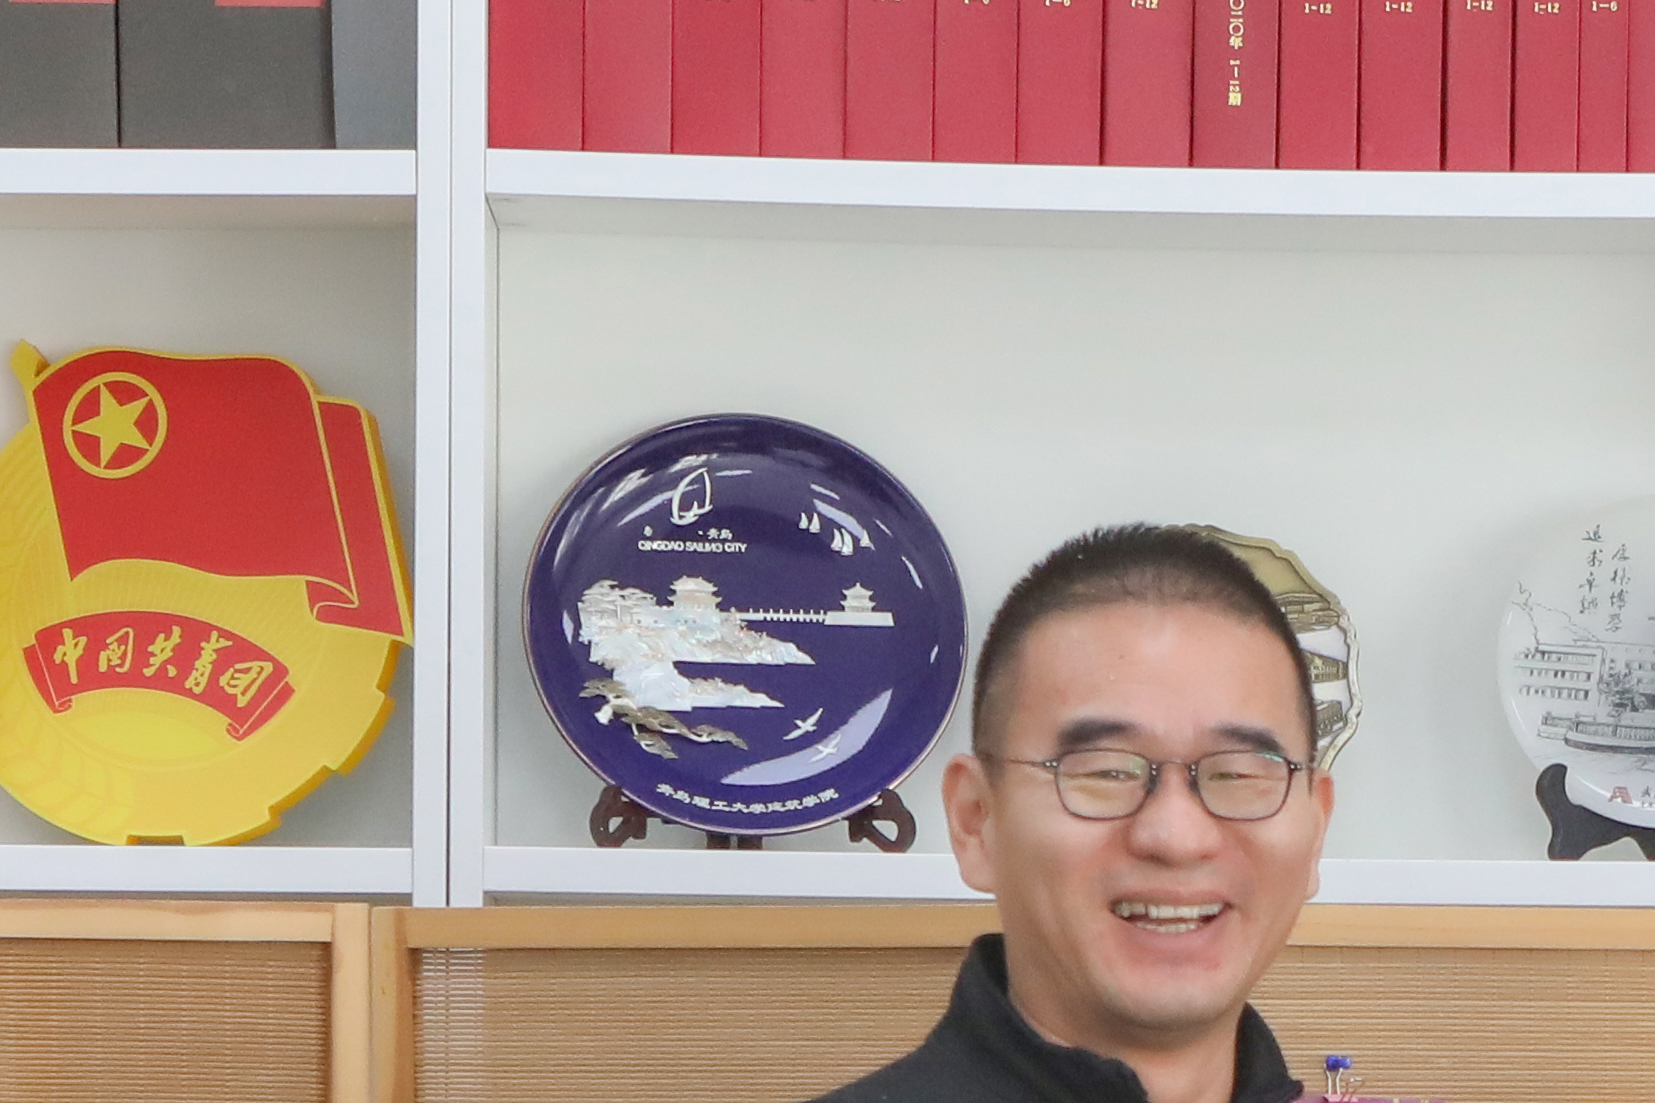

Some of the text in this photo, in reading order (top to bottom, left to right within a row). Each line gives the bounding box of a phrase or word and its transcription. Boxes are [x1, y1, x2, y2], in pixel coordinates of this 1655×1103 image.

[1304, 2, 1332, 15] 1-12
[1385, 1, 1413, 13] 1-12
[1466, 0, 1493, 11] 1-12
[1534, 1, 1560, 15] 1-12
[1592, 0, 1618, 12] 1-6
[637, 540, 685, 551] QINGDAO
[724, 542, 748, 553] CITY
[53, 626, 273, 707] 中国共青团
